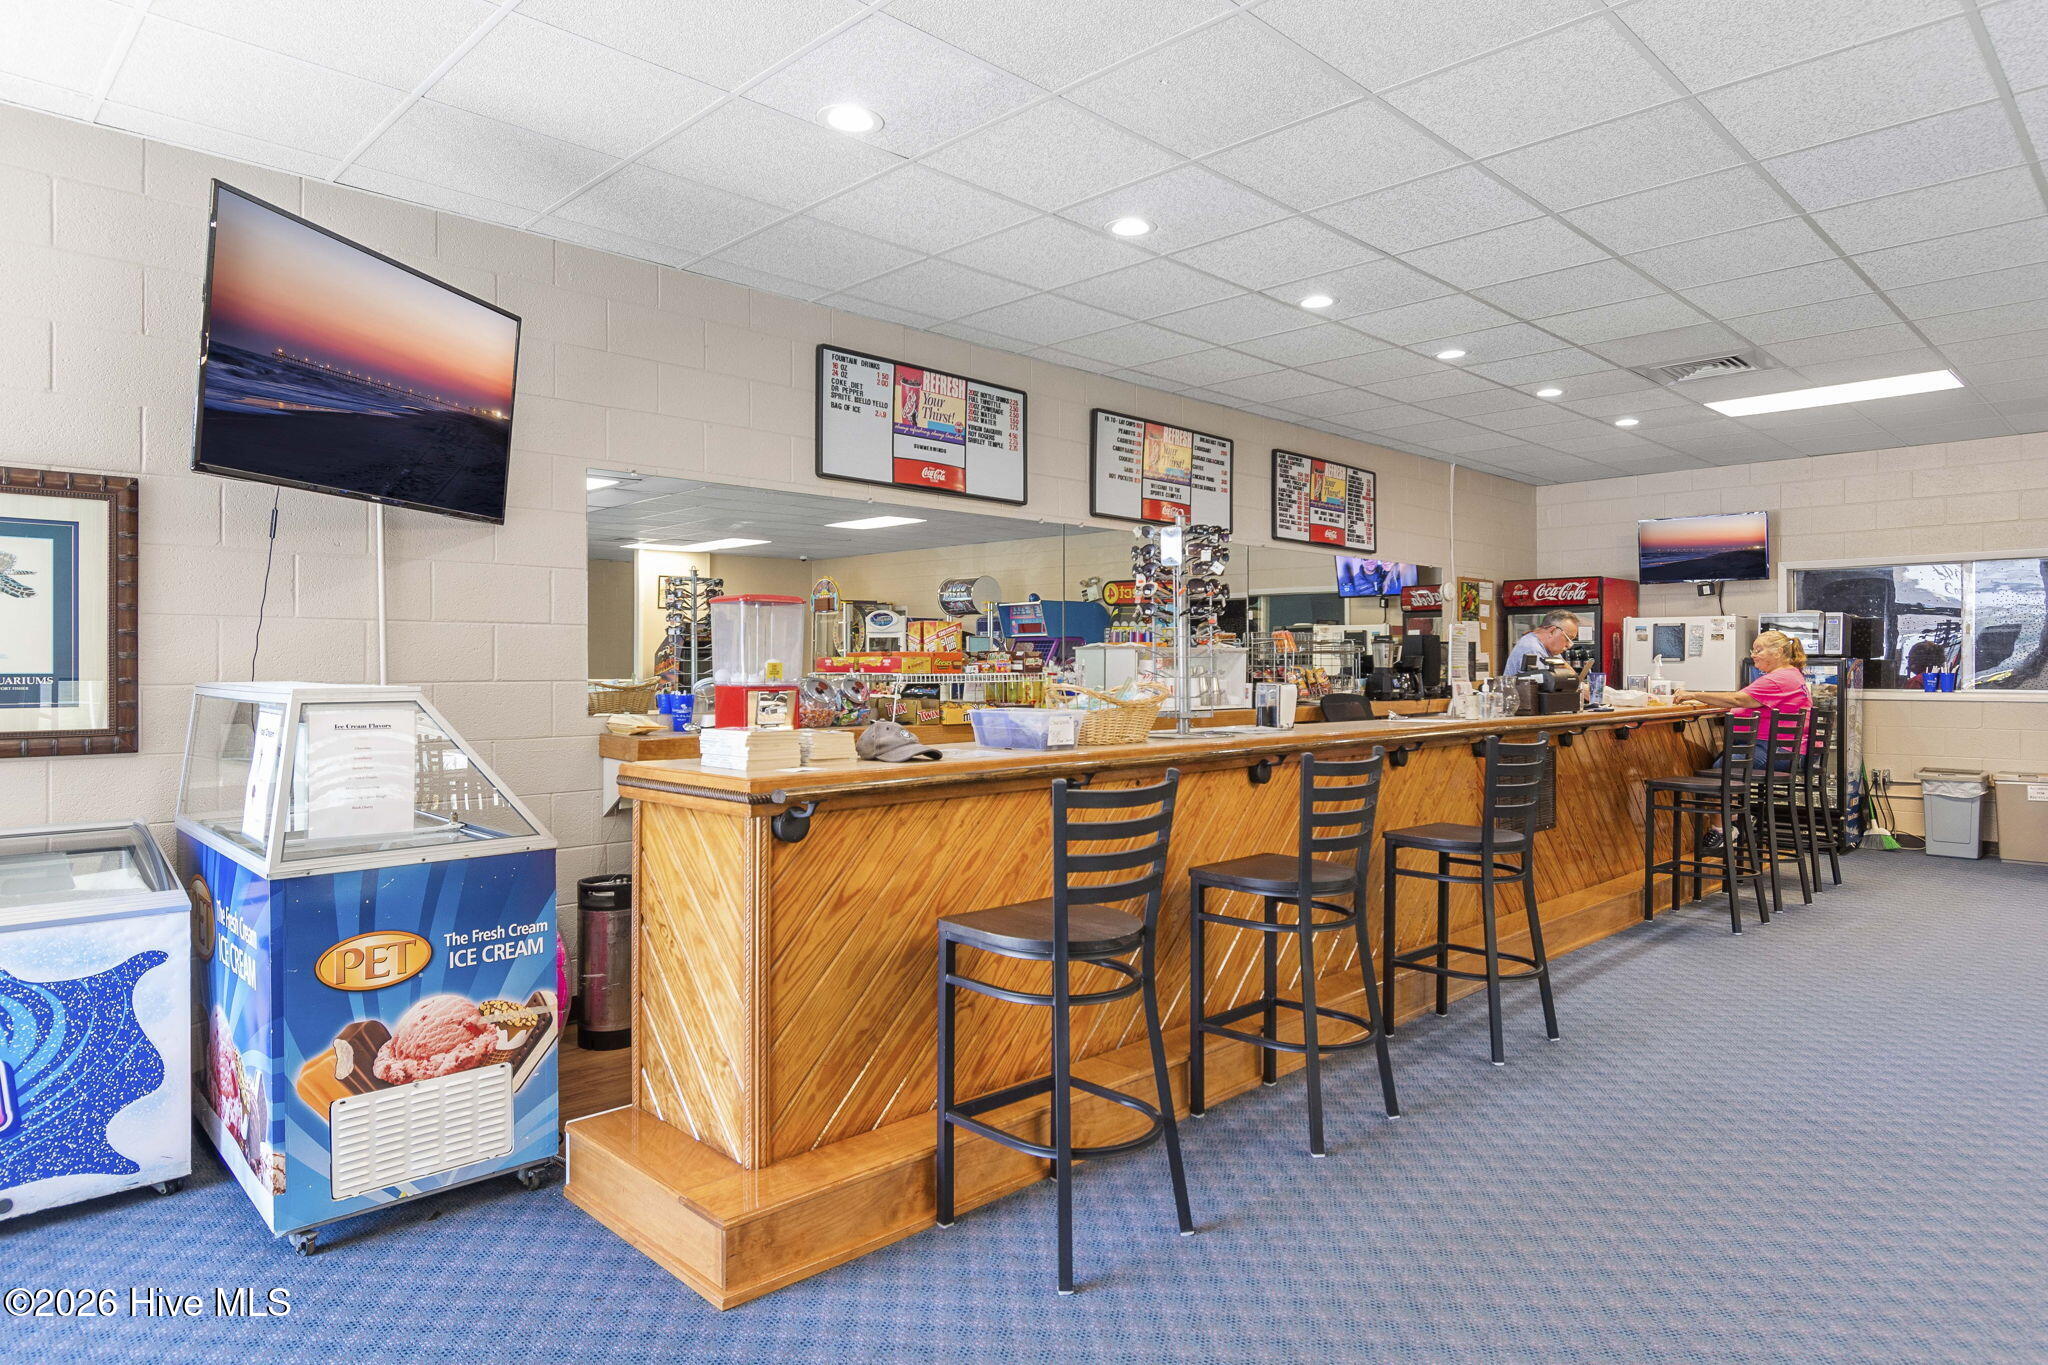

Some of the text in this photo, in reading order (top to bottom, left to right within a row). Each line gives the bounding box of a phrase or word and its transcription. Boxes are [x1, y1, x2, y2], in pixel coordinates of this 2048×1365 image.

[832, 354, 880, 370] FOUNTAIN DRINKS
[842, 387, 863, 397] PEPPER
[851, 382, 863, 390] DIET
[923, 371, 966, 400] REFRESH
[831, 402, 842, 410] BAG
[854, 396, 871, 405] MELLO
[923, 392, 945, 407] Your
[922, 406, 955, 424] Thirst!
[980, 411, 996, 420] WATER
[980, 418, 996, 426] WATER
[1164, 426, 1193, 448] REFRESH
[922, 466, 946, 481] Coca-Cola
[1533, 582, 1590, 601] Coca-Cola
[226, 907, 240, 935] Fresh
[240, 917, 257, 950] Cream
[444, 920, 548, 947] The Fresh Cream
[450, 937, 543, 968] ICE CREAM
[218, 933, 256, 991] ICE CREAM
[335, 939, 417, 985] PET
